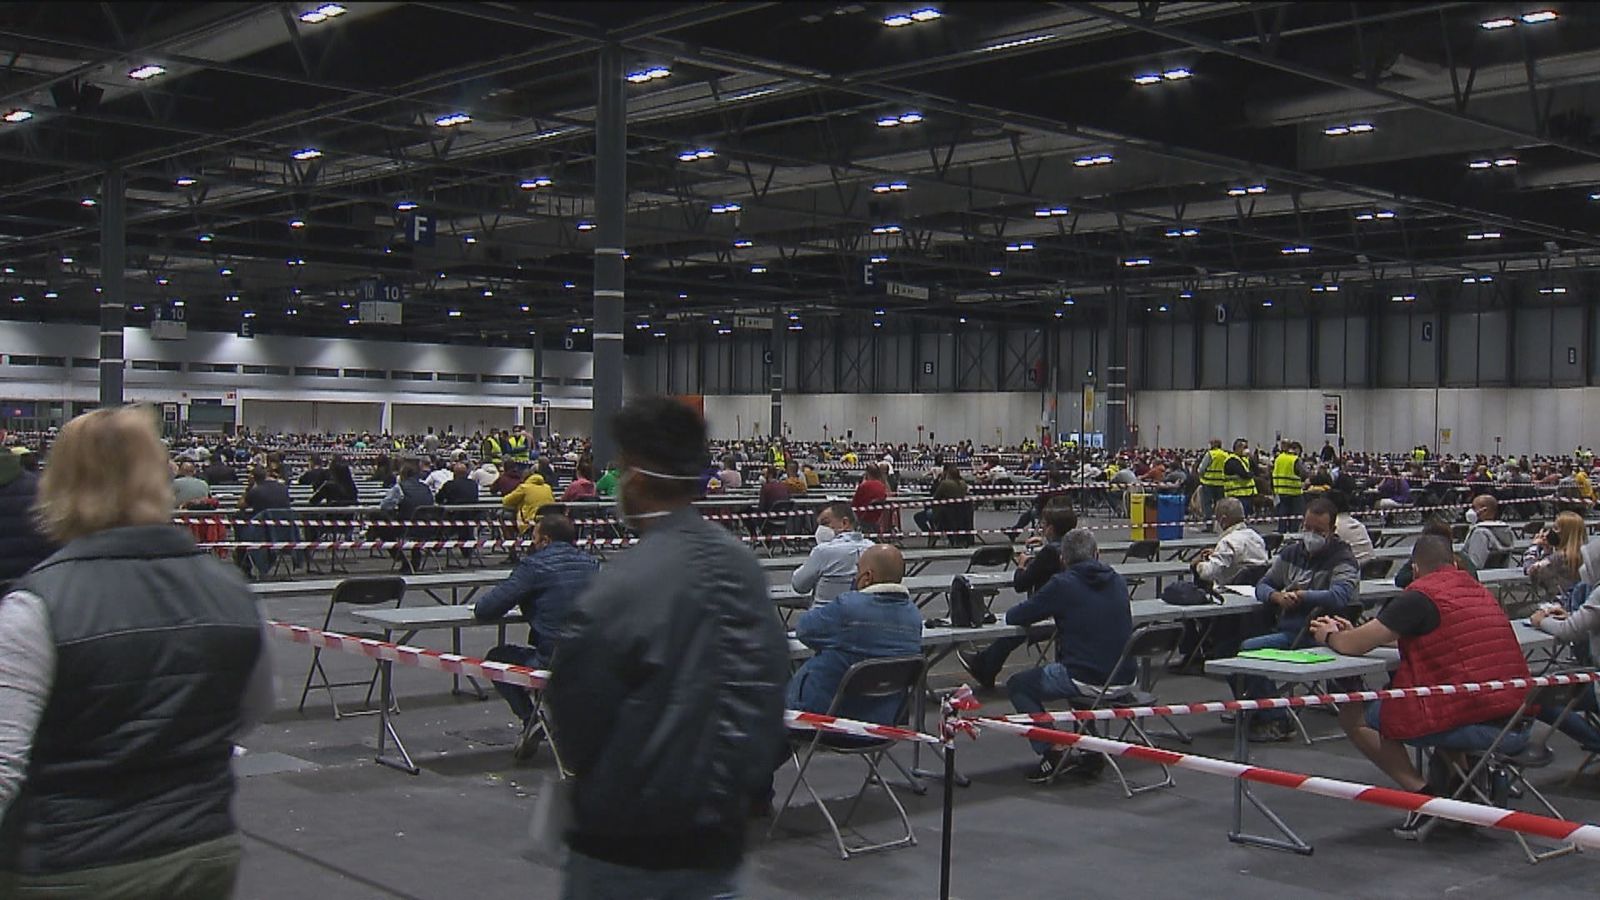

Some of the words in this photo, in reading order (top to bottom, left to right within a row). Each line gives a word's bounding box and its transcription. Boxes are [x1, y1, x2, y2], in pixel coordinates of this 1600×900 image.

[414, 216, 428, 241] F
[864, 265, 874, 285] E
[384, 286, 399, 300] 10
[171, 308, 184, 320] 10
[1217, 304, 1226, 323] D
[241, 323, 249, 336] E
